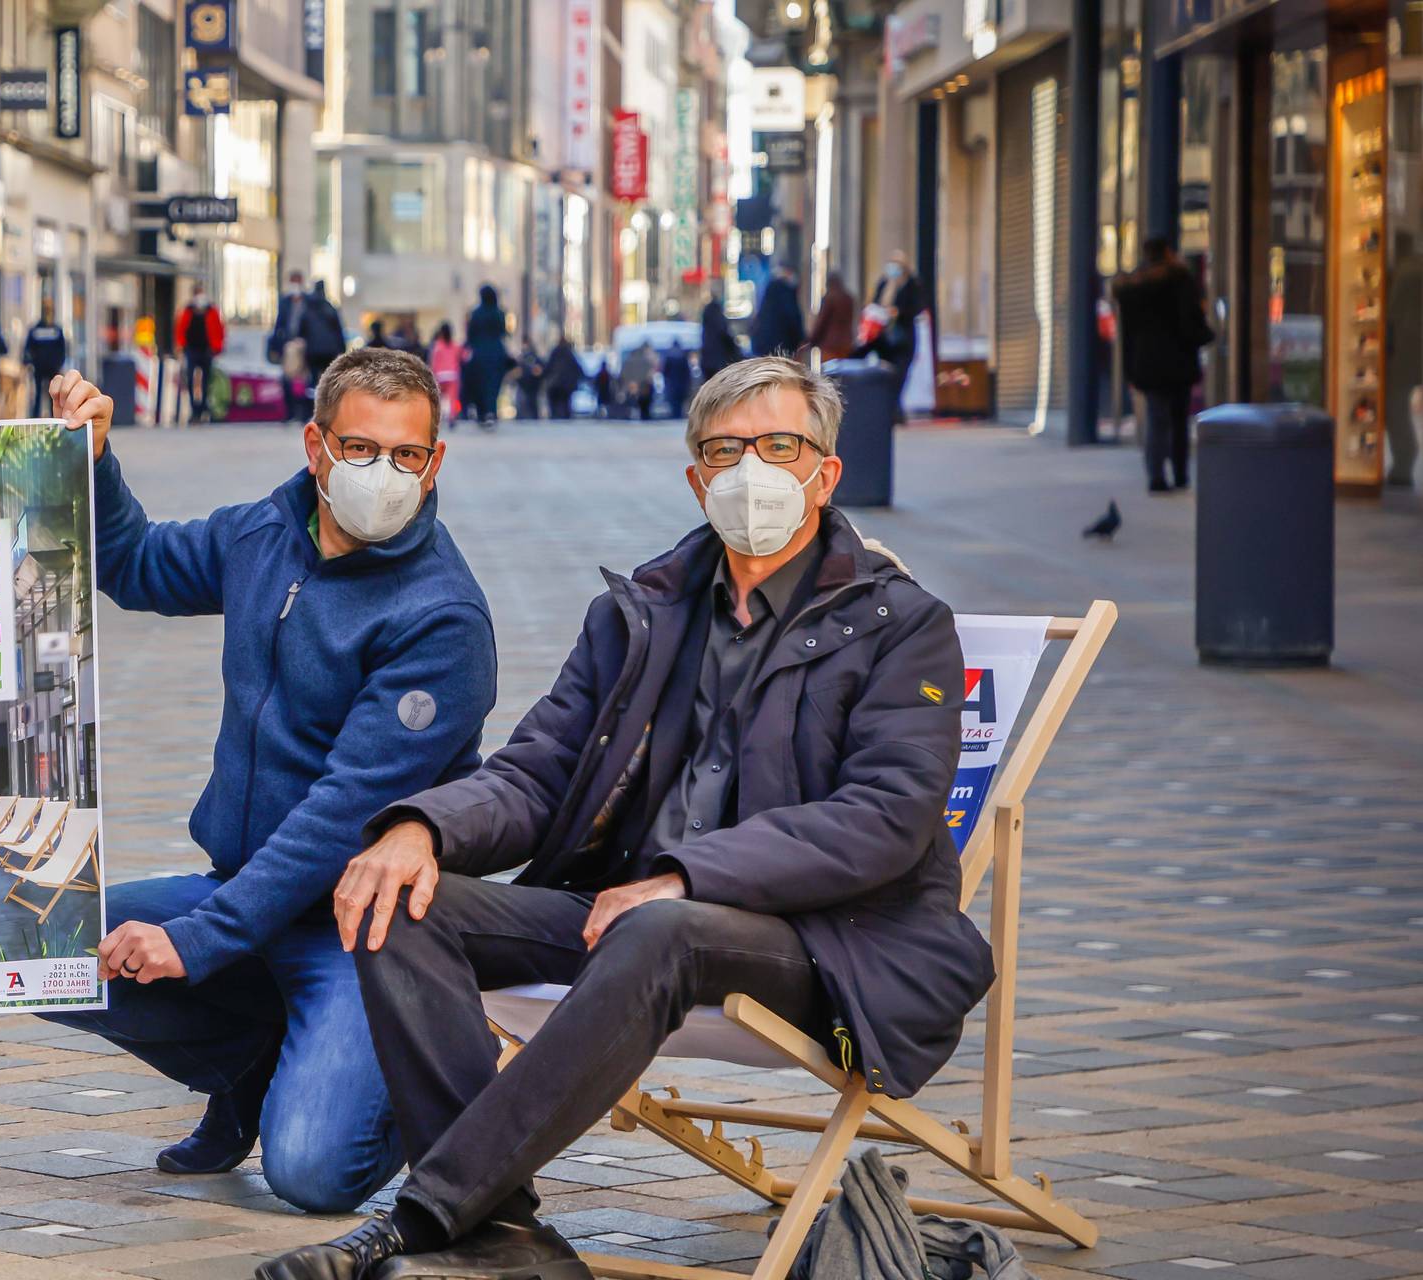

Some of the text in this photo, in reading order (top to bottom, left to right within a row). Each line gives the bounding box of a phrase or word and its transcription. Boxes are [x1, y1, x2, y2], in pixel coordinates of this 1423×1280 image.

[53, 963, 67, 971] 321
[49, 971, 67, 979] 2021
[42, 980, 91, 988] 1700 JAHRE
